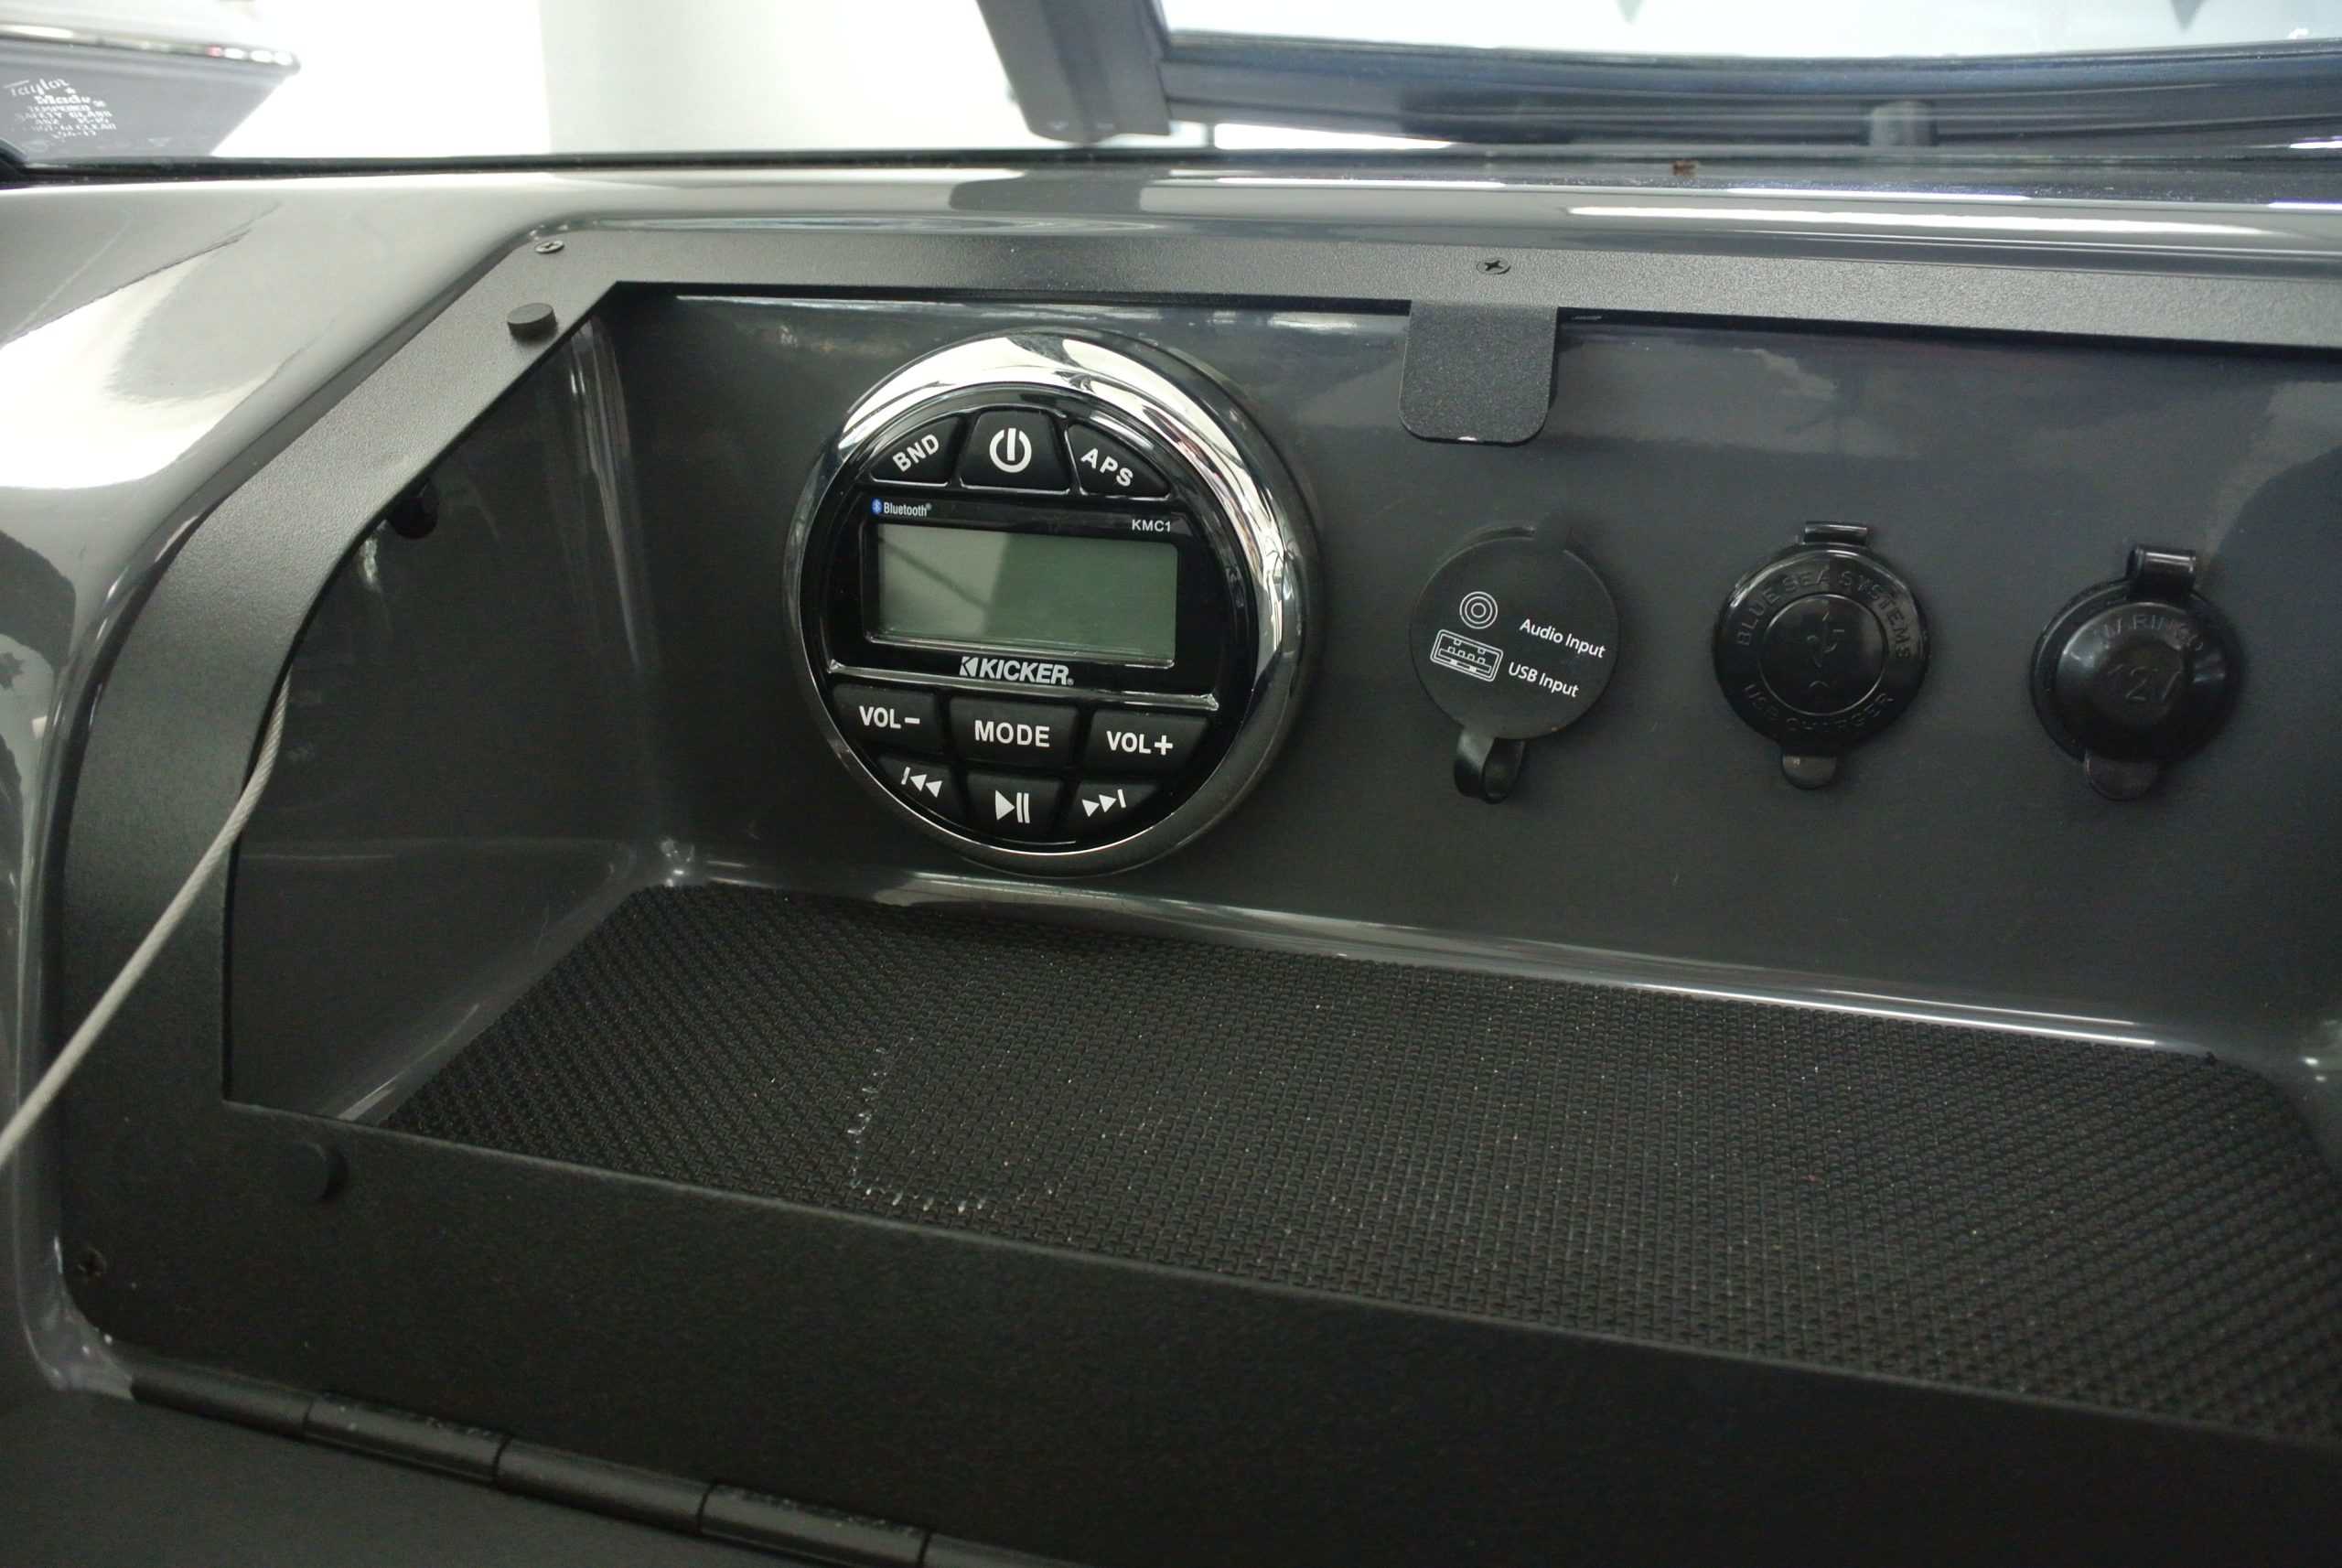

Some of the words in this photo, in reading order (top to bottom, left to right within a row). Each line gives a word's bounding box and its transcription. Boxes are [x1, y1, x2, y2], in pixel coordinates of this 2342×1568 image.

[3, 78, 70, 96] Taylor
[892, 433, 940, 472] BND
[1080, 447, 1133, 488] APS
[1131, 519, 1172, 533] KMC1
[1519, 618, 1563, 644] Audio
[1565, 633, 1606, 659] Input
[1508, 661, 1538, 682] USB
[1539, 672, 1580, 698] Input
[974, 719, 1050, 747] MODE
[1106, 730, 1174, 756] VOL+
